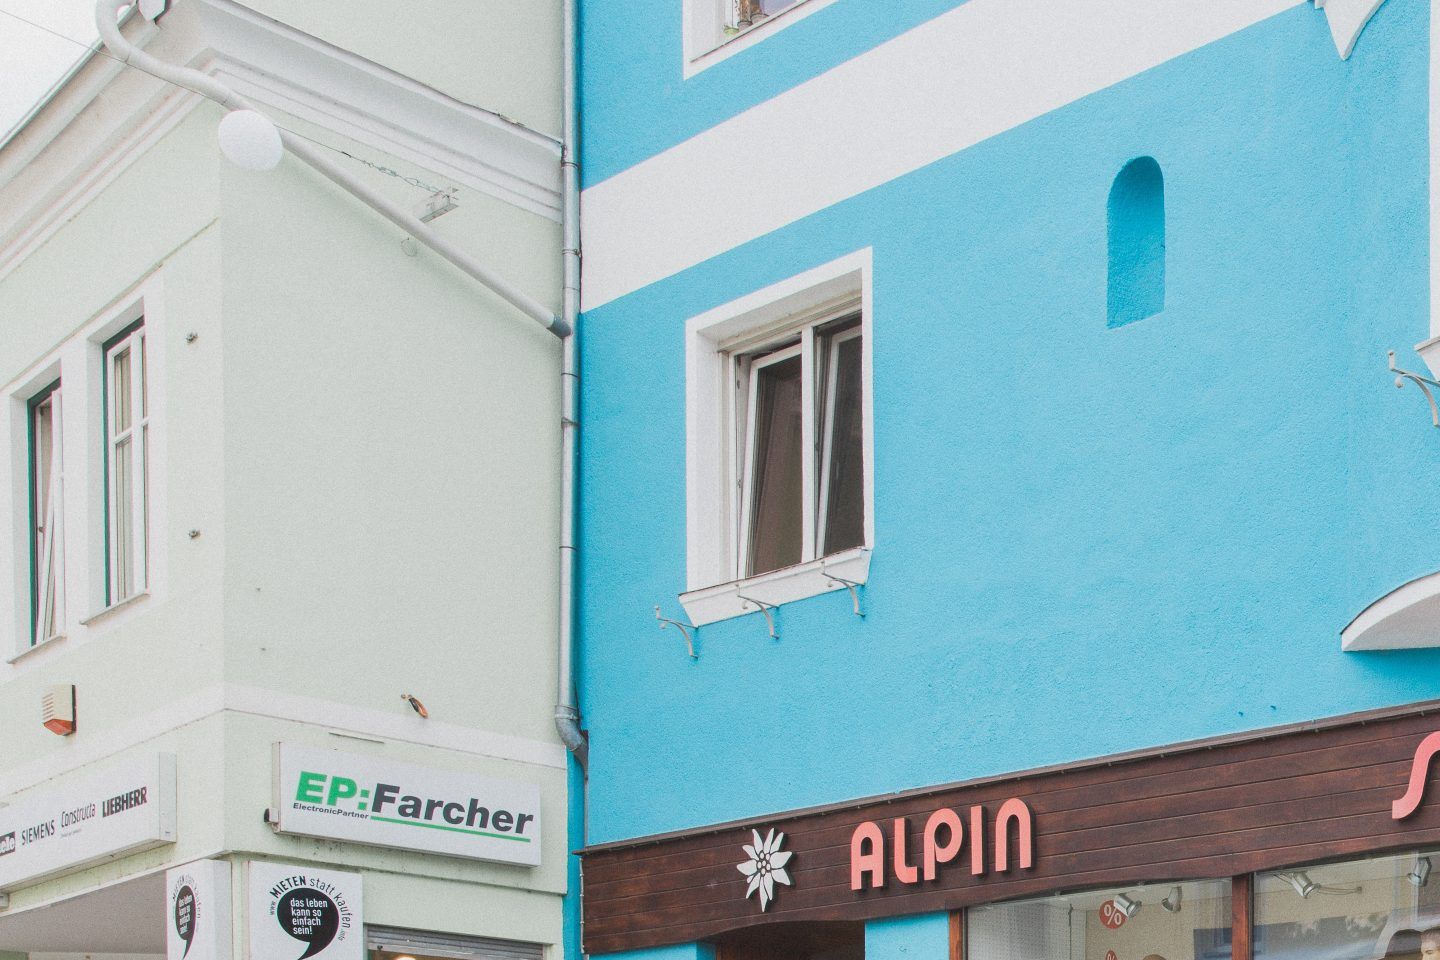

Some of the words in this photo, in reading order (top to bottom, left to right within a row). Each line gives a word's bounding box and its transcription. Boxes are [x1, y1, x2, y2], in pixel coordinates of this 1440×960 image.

[102, 786, 147, 818] LIEBHERR
[293, 802, 369, 820] ElectronicPartner
[61, 803, 96, 828] Constructa
[21, 820, 55, 845] SIEMENS
[851, 797, 1032, 891] ALPIN
[290, 897, 304, 907] das
[305, 898, 328, 908] leben
[291, 907, 311, 917] kann
[312, 909, 322, 917] so
[292, 917, 321, 926] einfach
[293, 926, 313, 935] sein!
